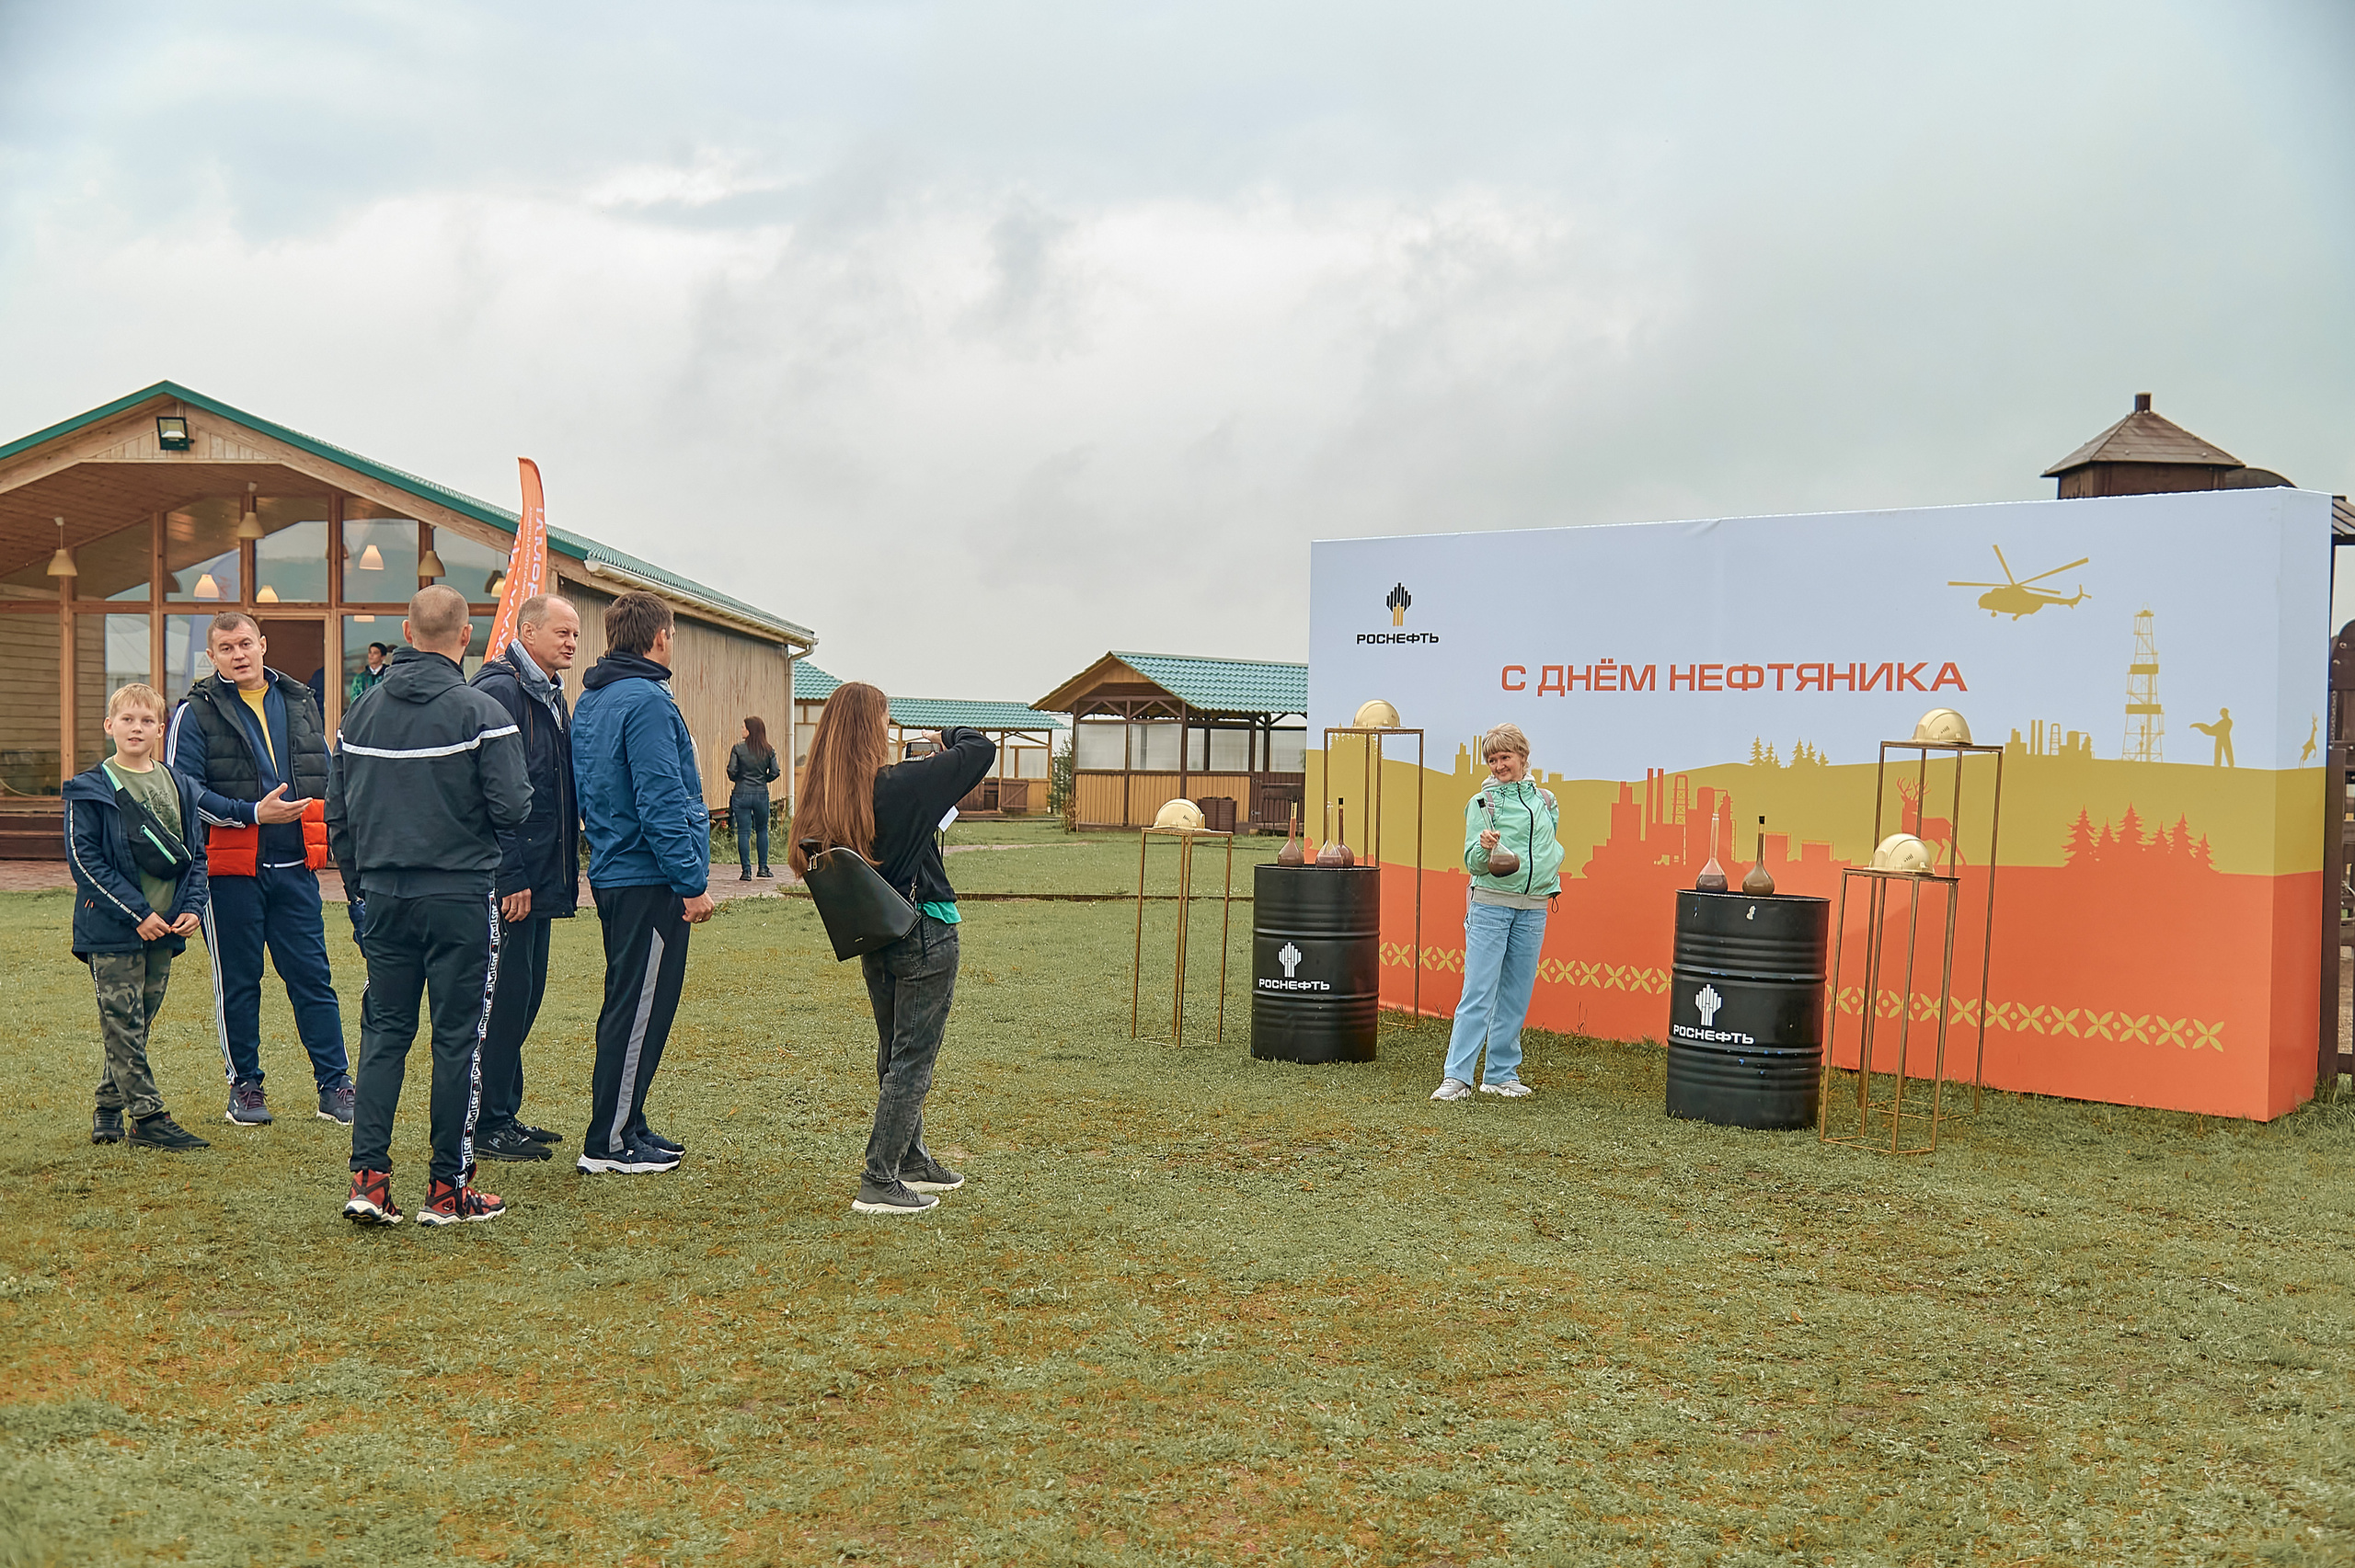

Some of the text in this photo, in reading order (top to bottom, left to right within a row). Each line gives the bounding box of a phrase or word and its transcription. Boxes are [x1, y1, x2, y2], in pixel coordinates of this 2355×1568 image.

[1356, 633, 1440, 645] РОСНЕФТЬ
[1501, 658, 1969, 697] С ДНЁМ НЕФТЯНИКА
[1258, 978, 1330, 990] РОСНЕФТЬ
[1673, 1024, 1754, 1045] РОСНЕФТЬ
[463, 1137, 473, 1155] JUST
[457, 1173, 466, 1188] JUS
